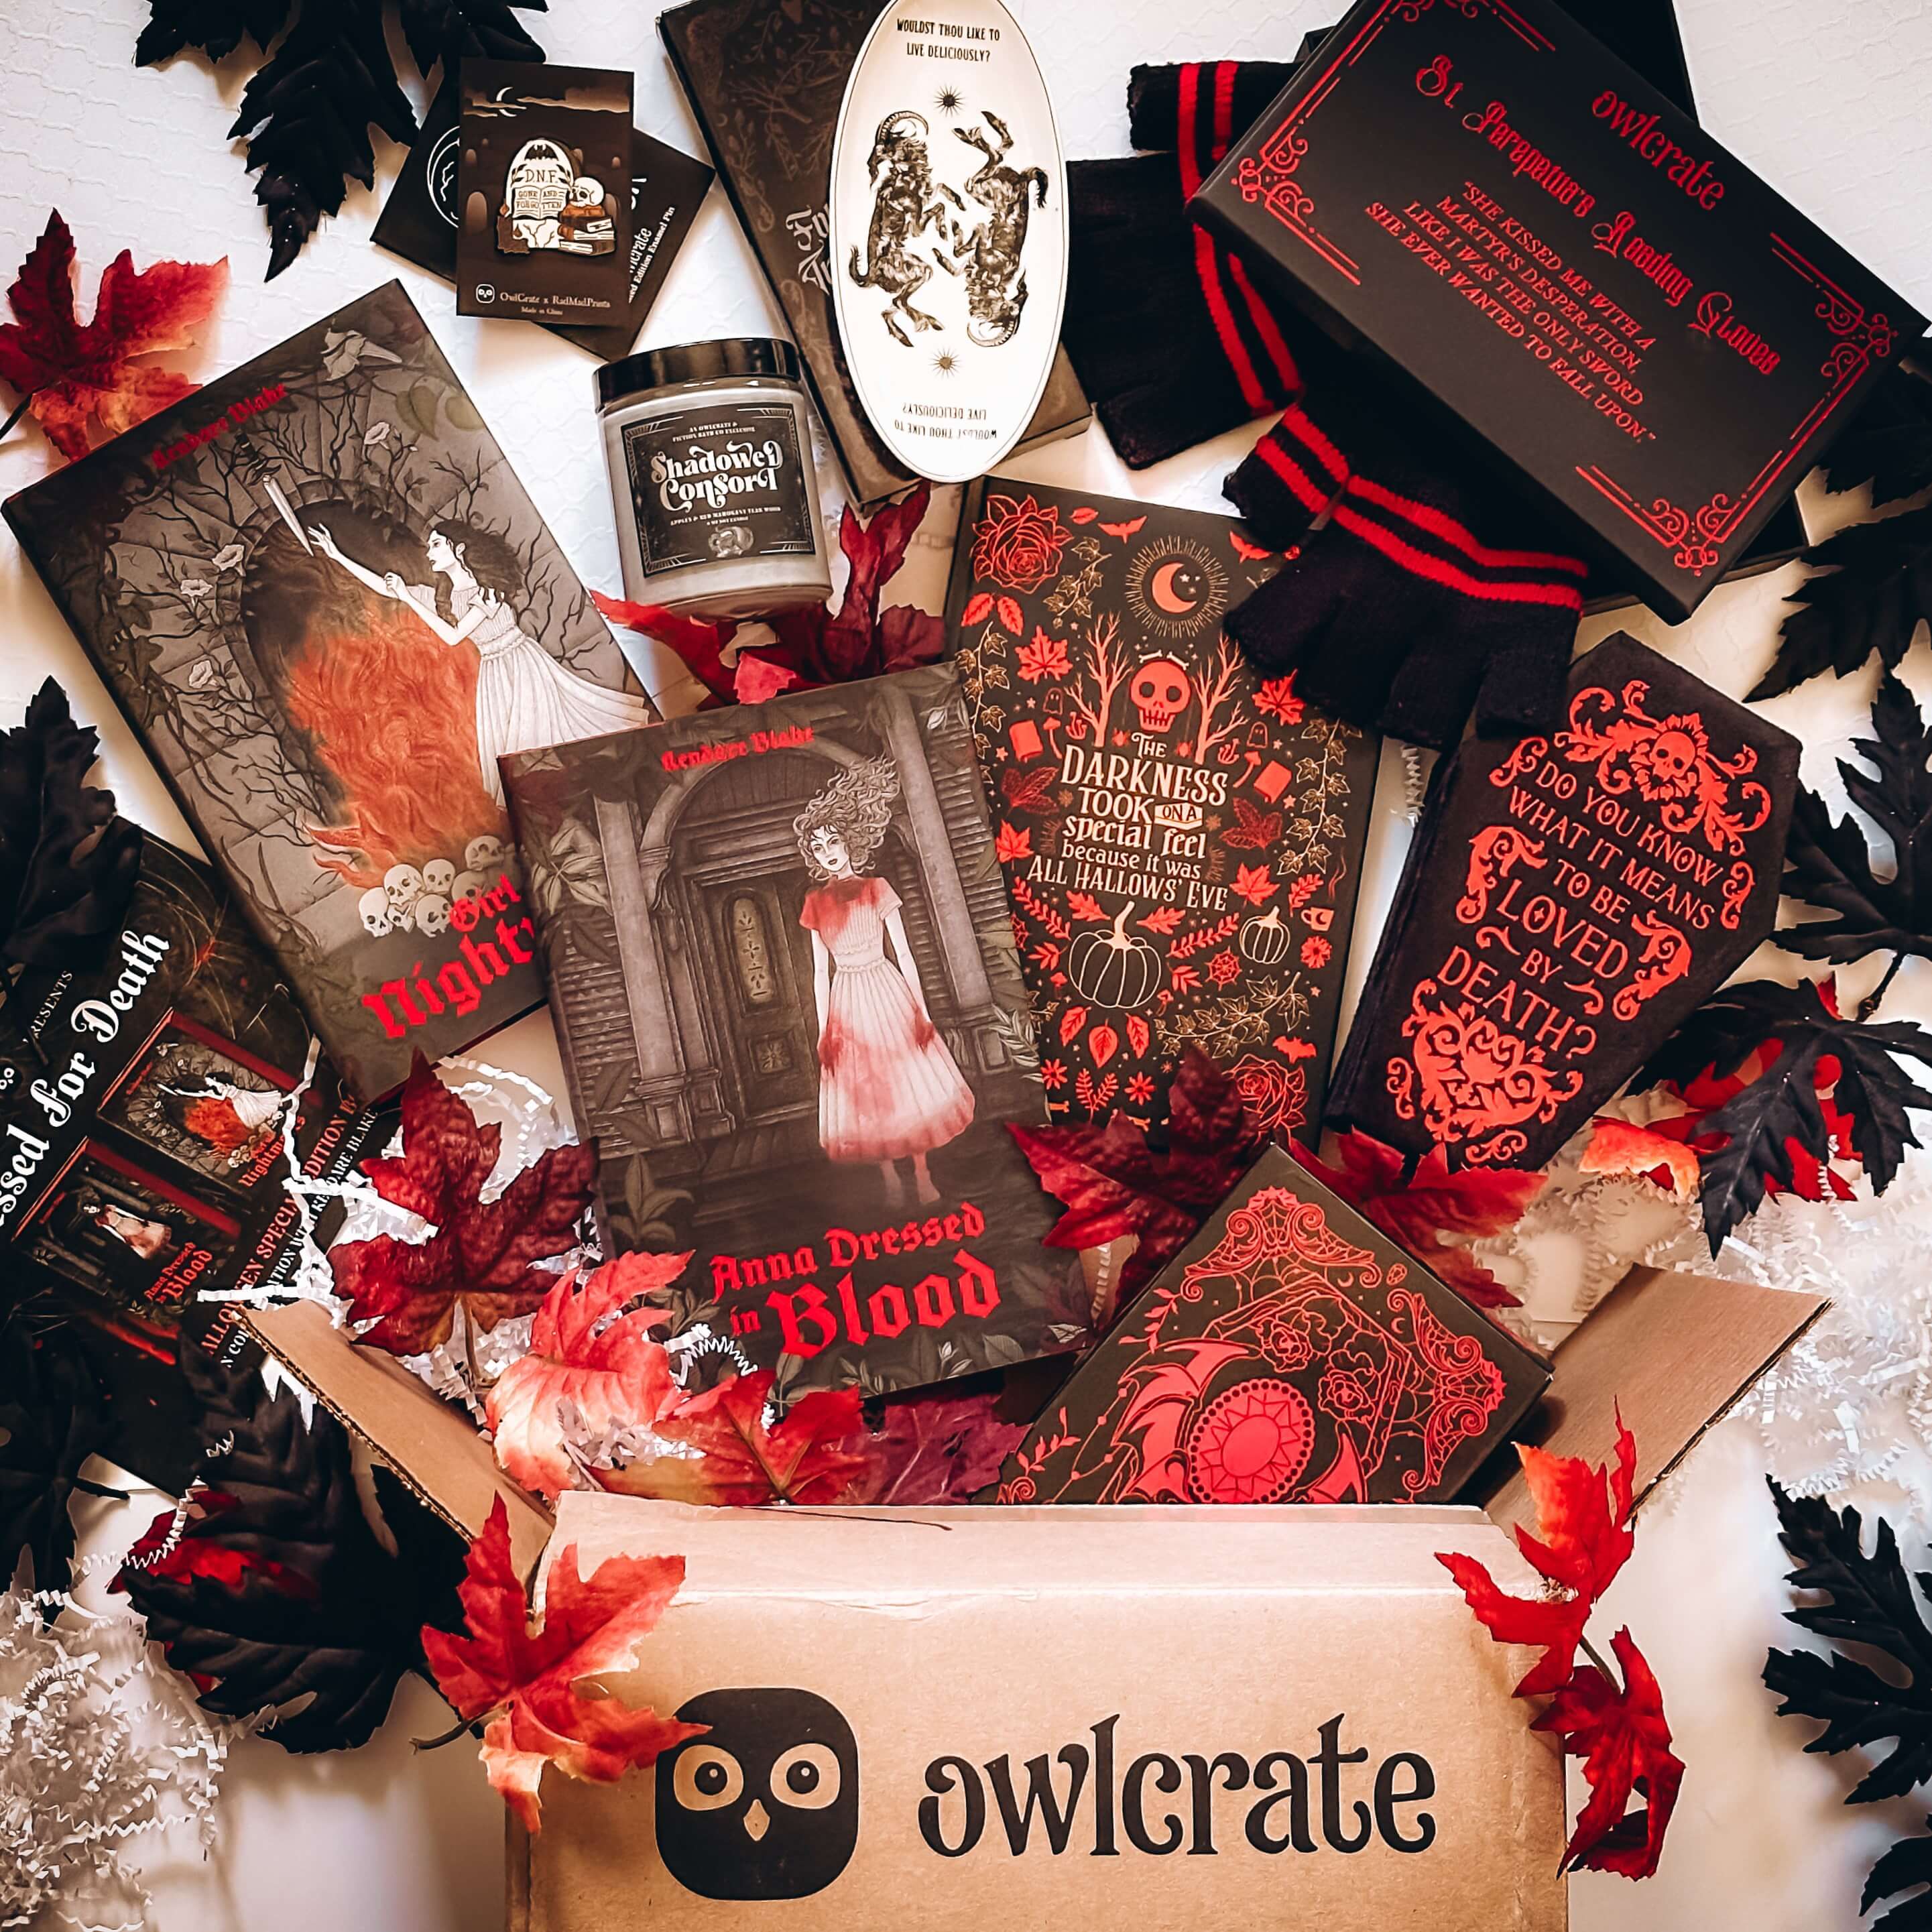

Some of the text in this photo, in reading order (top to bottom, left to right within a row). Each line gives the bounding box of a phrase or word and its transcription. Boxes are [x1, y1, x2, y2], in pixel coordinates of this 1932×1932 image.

[896, 18, 1000, 41] WOULDST THOU LIKE TO
[906, 42, 991, 62] LIVE DELICIOUSLY?
[1591, 90, 1725, 210] owlcrate
[633, 254, 654, 284] Edition
[662, 206, 676, 223] Pin
[1436, 196, 1524, 271] MARTYR'S
[1364, 202, 1406, 237] SHE
[1400, 231, 1451, 276] EVER
[1448, 271, 1524, 338] WANTED
[1524, 334, 1553, 360] TO
[1549, 357, 1595, 400] FALL
[1402, 200, 1643, 405] LIKE I WAS THE ONLY SWORD
[1498, 217, 1563, 270] KISSED
[1559, 268, 1593, 297] ME
[1589, 292, 1642, 338] WITH
[1634, 338, 1656, 351] A
[1591, 211, 1694, 308] Reading
[1688, 291, 1780, 375] Gloves
[894, 419, 904, 431] TO
[902, 402, 987, 420] LIVE DELICIOUSLY?
[908, 422, 925, 436] LIKE
[929, 426, 952, 439] THOU
[1061, 744, 1229, 806] DARKNESS
[1077, 786, 1197, 825] TOOK ON A
[1063, 814, 1207, 859] special feel
[1508, 785, 1715, 930] WHAT IT MEANS
[1535, 762, 1724, 888] DO YOU KNOW
[1026, 854, 1069, 885] ALL
[1187, 880, 1229, 911] EVE
[1061, 839, 1202, 880] because it was
[1552, 857, 1632, 924] TO BE
[1495, 879, 1630, 980] LOVED
[1520, 947, 1563, 984] BY
[29, 1052, 96, 1128] for
[70, 930, 170, 1043] Death
[1437, 945, 1598, 1061] DEATH?
[346, 1109, 378, 1152] BLAKE
[162, 1249, 213, 1299] Blood
[709, 1201, 986, 1305] Anna Dressed
[144, 1276, 168, 1301] Anna
[729, 1248, 1002, 1360] in Blood
[918, 1713, 1436, 1857] owlcrate
